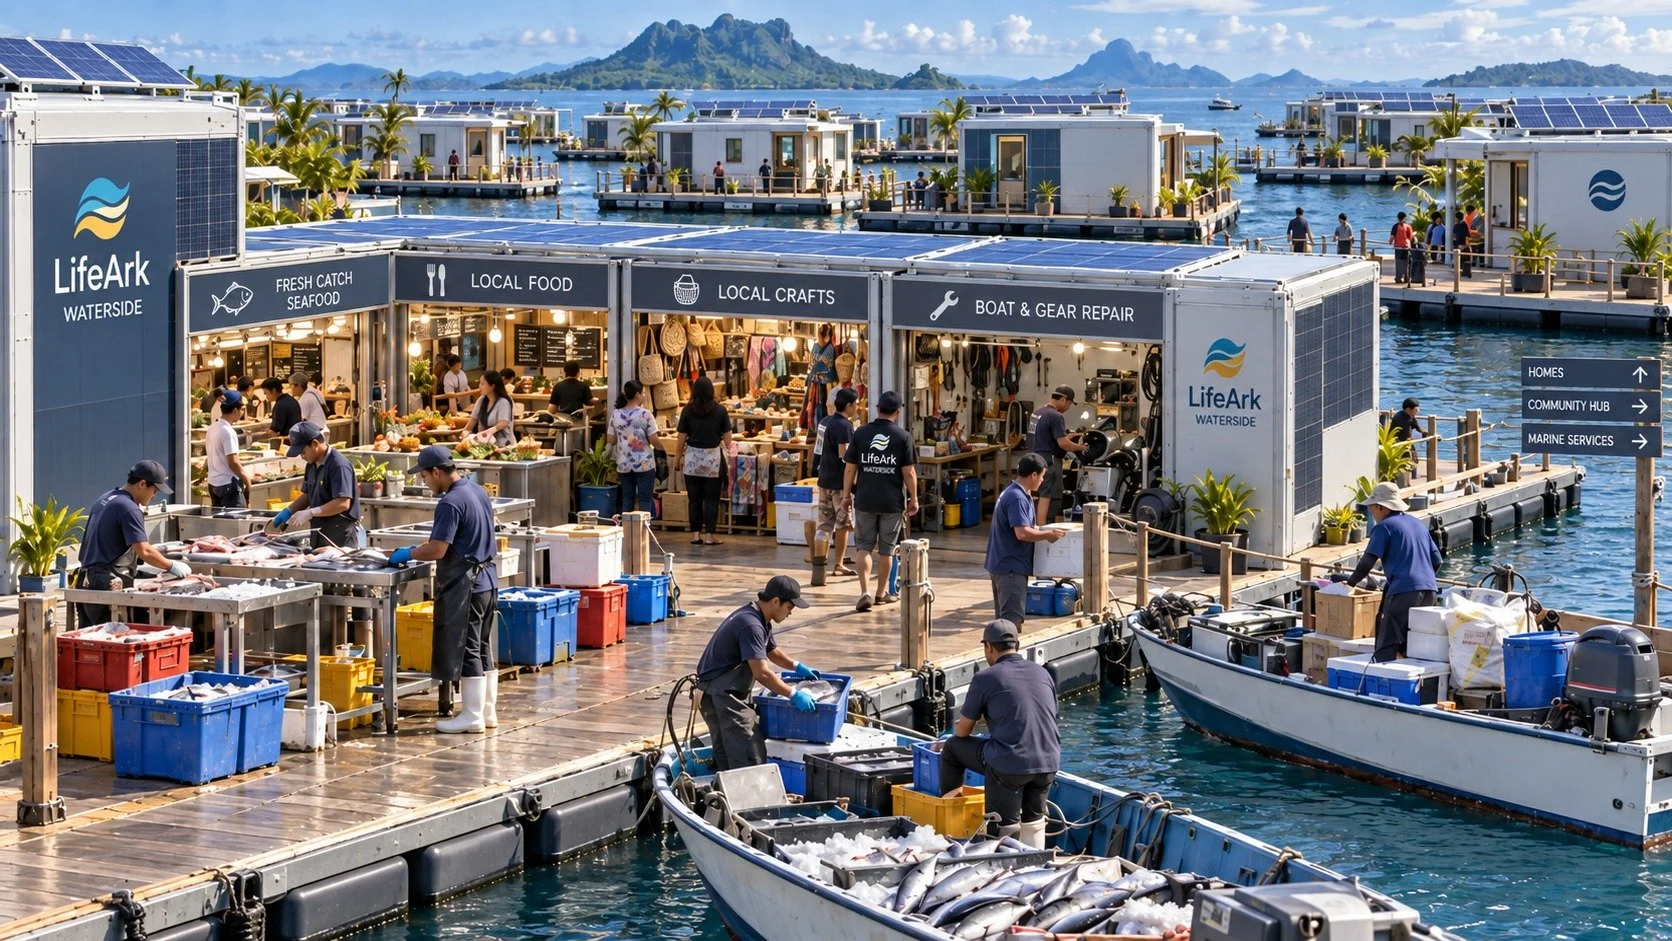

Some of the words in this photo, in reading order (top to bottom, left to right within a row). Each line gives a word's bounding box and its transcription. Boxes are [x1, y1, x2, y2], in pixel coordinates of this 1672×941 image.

[55, 251, 149, 295] LifeArk
[276, 276, 312, 293] FRESH
[316, 271, 353, 288] CATCH
[471, 273, 522, 290] LOCAL
[528, 275, 573, 292] FOOD
[287, 291, 340, 310] SEAFOOD
[718, 285, 771, 302] LOCAL
[776, 288, 835, 305] CRAFTS
[64, 299, 142, 322] WATERSIDE
[976, 300, 1016, 316] BOAT
[1020, 302, 1031, 317] &
[1036, 303, 1077, 319] GEAR
[1083, 305, 1134, 322] REPAIR
[1528, 366, 1564, 379] HOMES
[1189, 386, 1262, 411] LifeArk
[1528, 399, 1587, 412] COMMUNITY
[1589, 401, 1611, 412] HUB
[1195, 414, 1256, 428] WATERSIDE
[1528, 433, 1565, 445] MARINE
[1568, 435, 1614, 447] SERVICES
[861, 452, 897, 465] LifeArk
